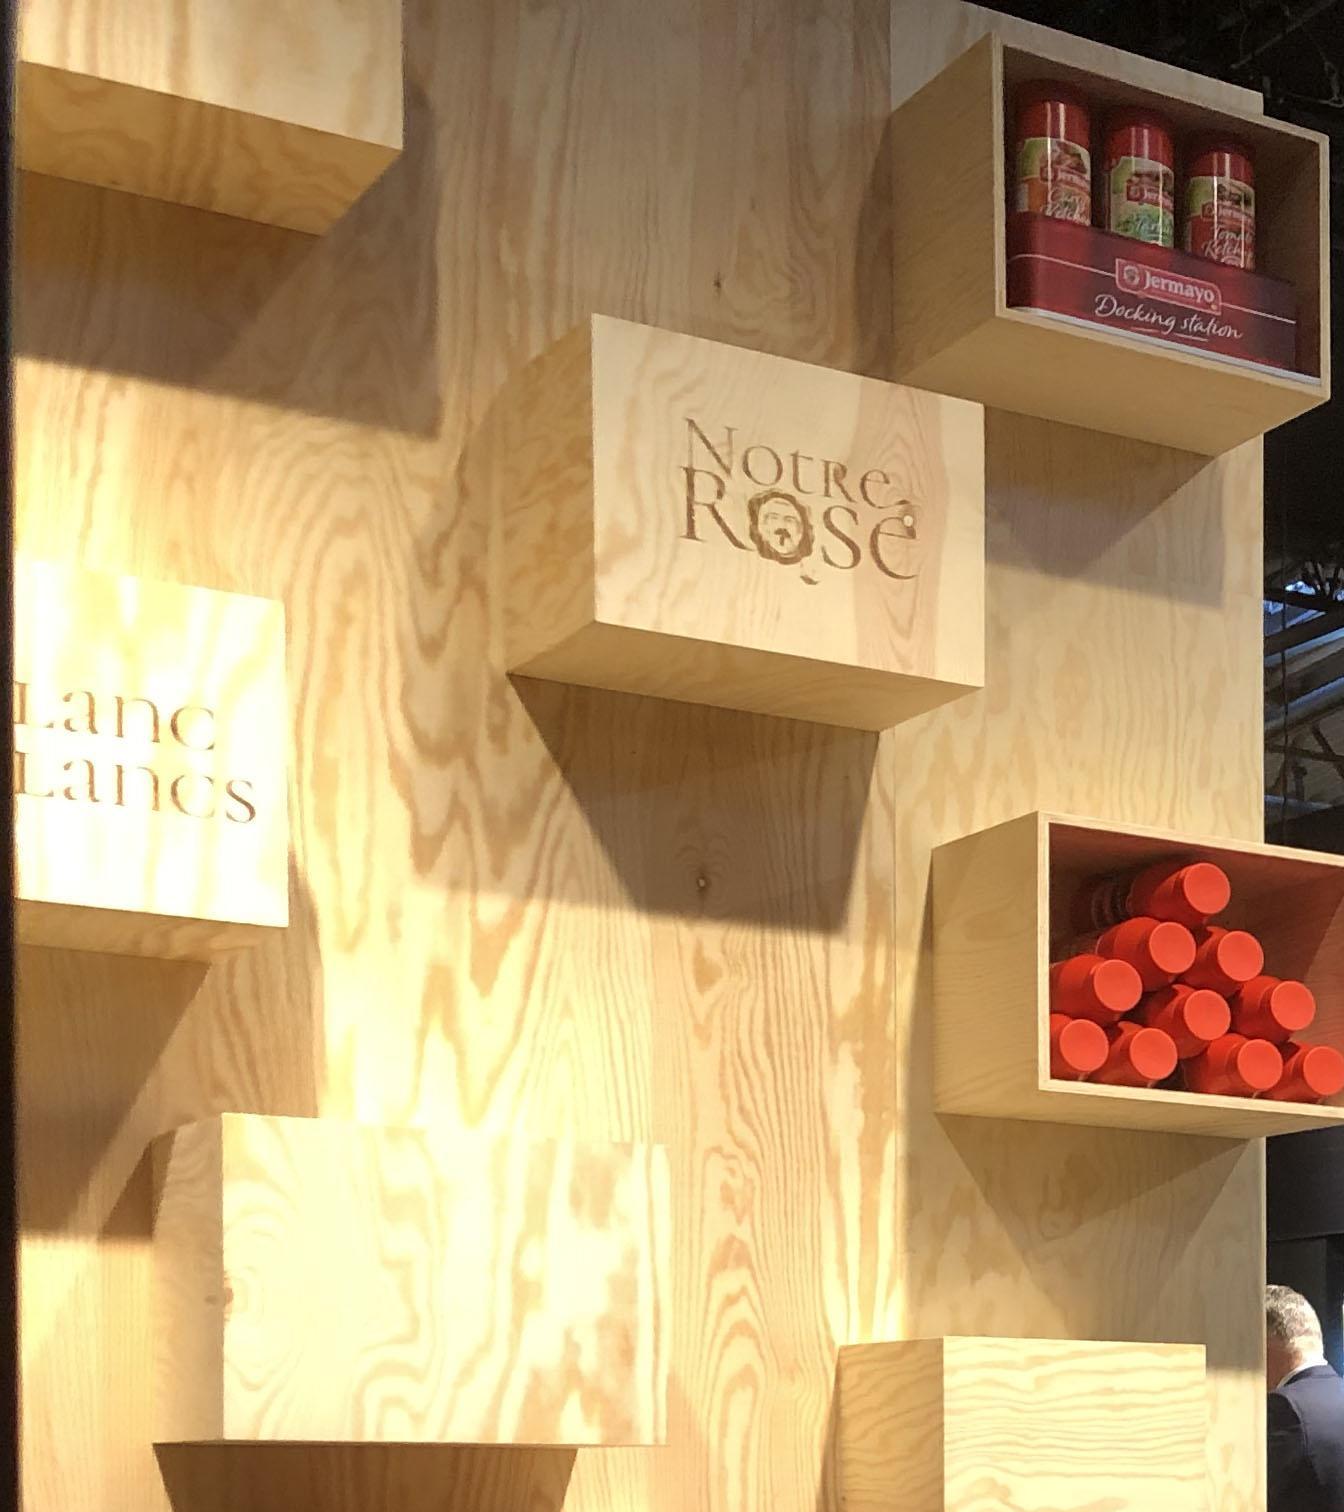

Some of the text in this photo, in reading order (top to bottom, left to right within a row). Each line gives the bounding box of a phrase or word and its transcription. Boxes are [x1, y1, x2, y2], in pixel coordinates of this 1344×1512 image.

[1144, 271, 1215, 303] Jermayo
[1095, 293, 1243, 340] Docking station
